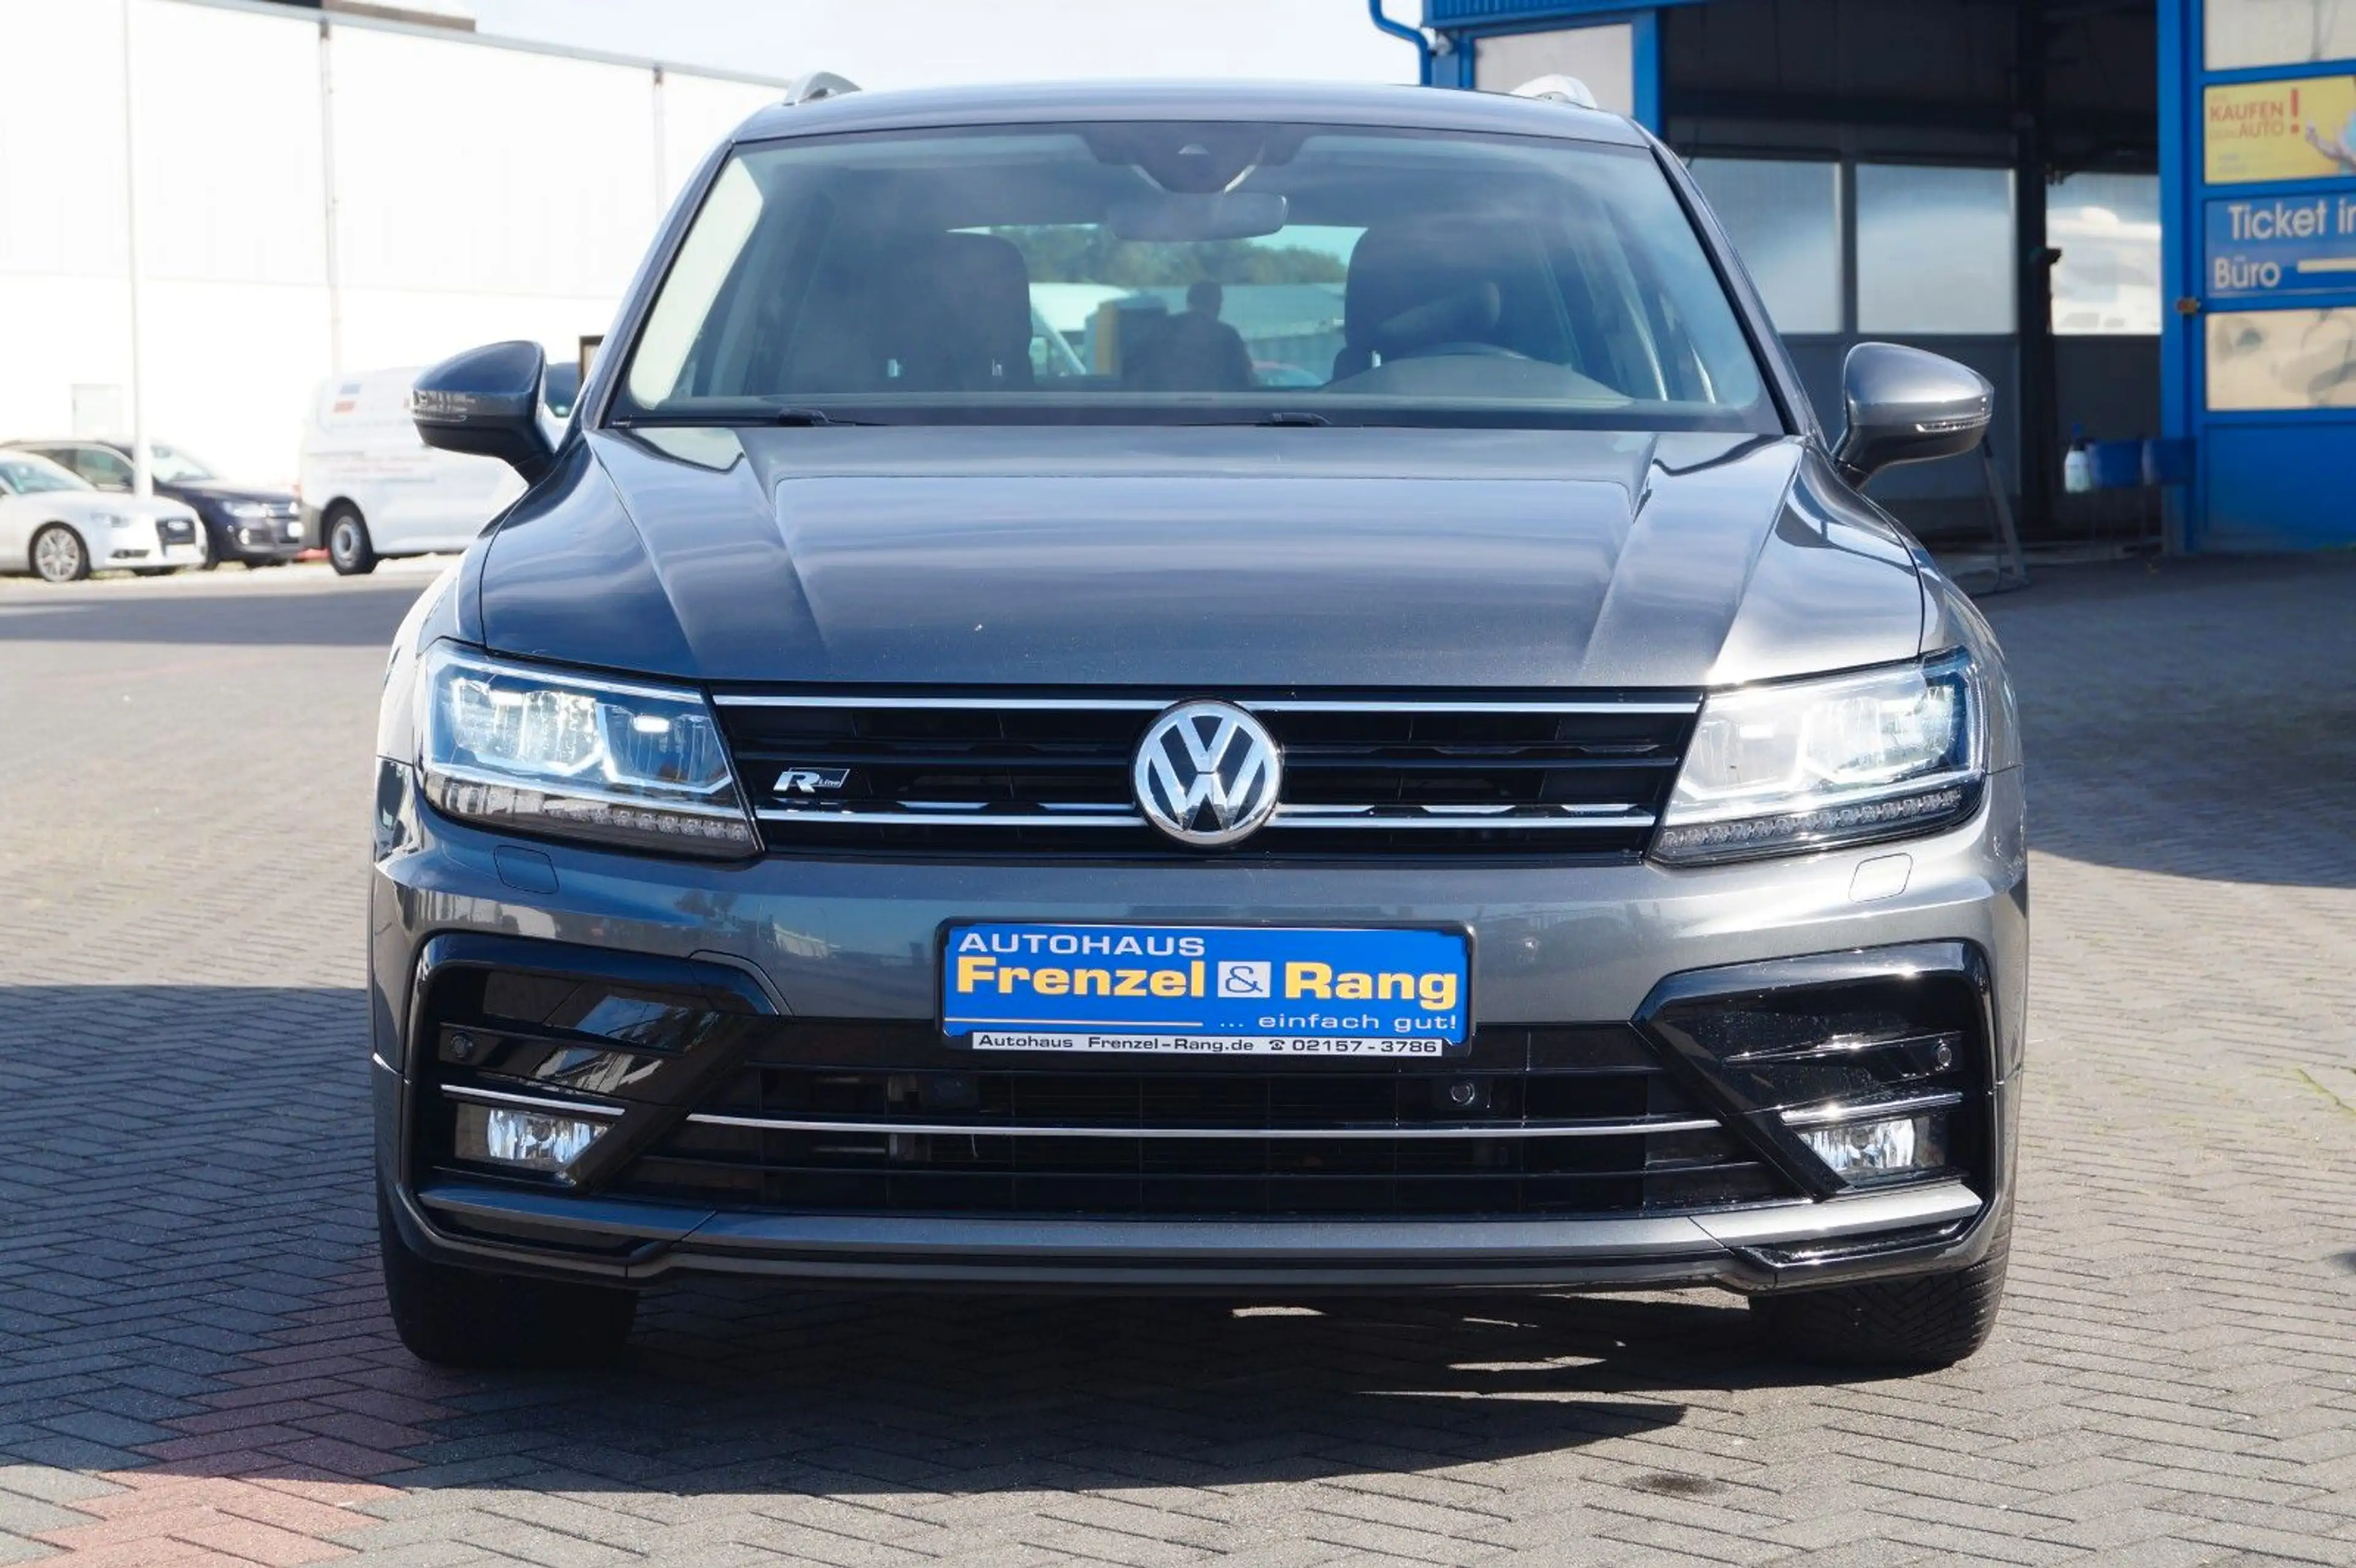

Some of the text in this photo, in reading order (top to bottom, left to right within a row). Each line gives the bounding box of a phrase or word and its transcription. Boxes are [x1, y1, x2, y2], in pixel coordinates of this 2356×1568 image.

[2228, 199, 2326, 240] Ticket
[2214, 254, 2281, 289] Büro
[958, 932, 1206, 957] AUTOHAUS
[957, 956, 1458, 1011] Frenzel & Rang
[1258, 1013, 1380, 1029] einfach
[1393, 1015, 1457, 1032] gut!
[978, 1034, 1074, 1048] Autohaus
